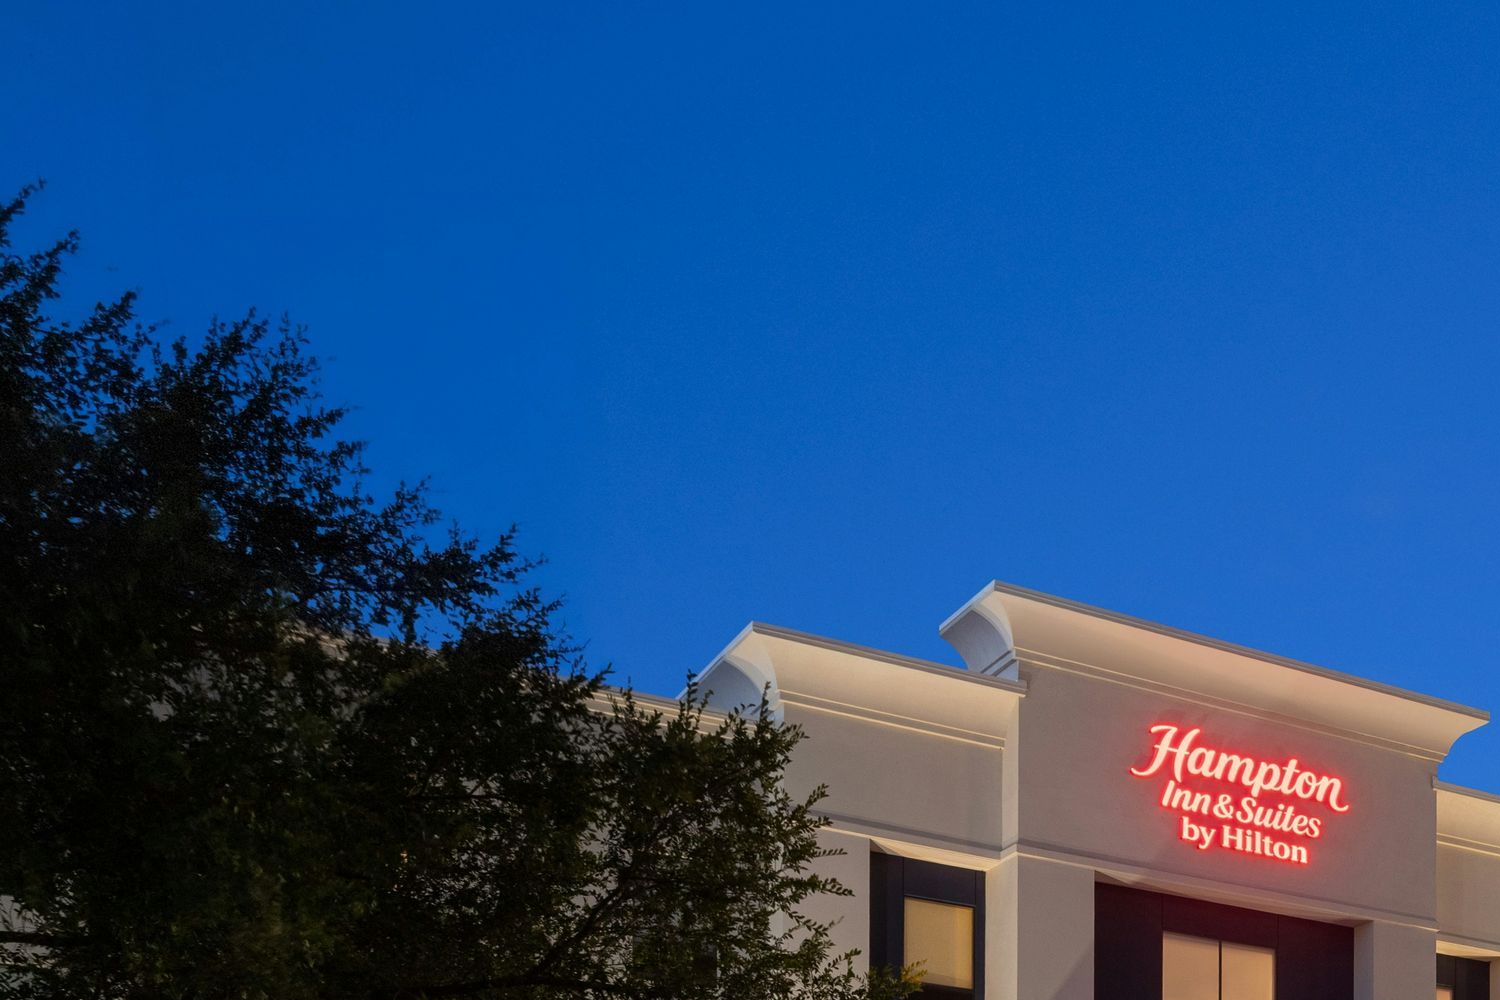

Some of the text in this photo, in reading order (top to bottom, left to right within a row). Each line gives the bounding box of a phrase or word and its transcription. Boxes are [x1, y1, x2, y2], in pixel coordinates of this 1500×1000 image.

[1130, 725, 1349, 812] Hampton
[1181, 816, 1308, 863] by Hilton
